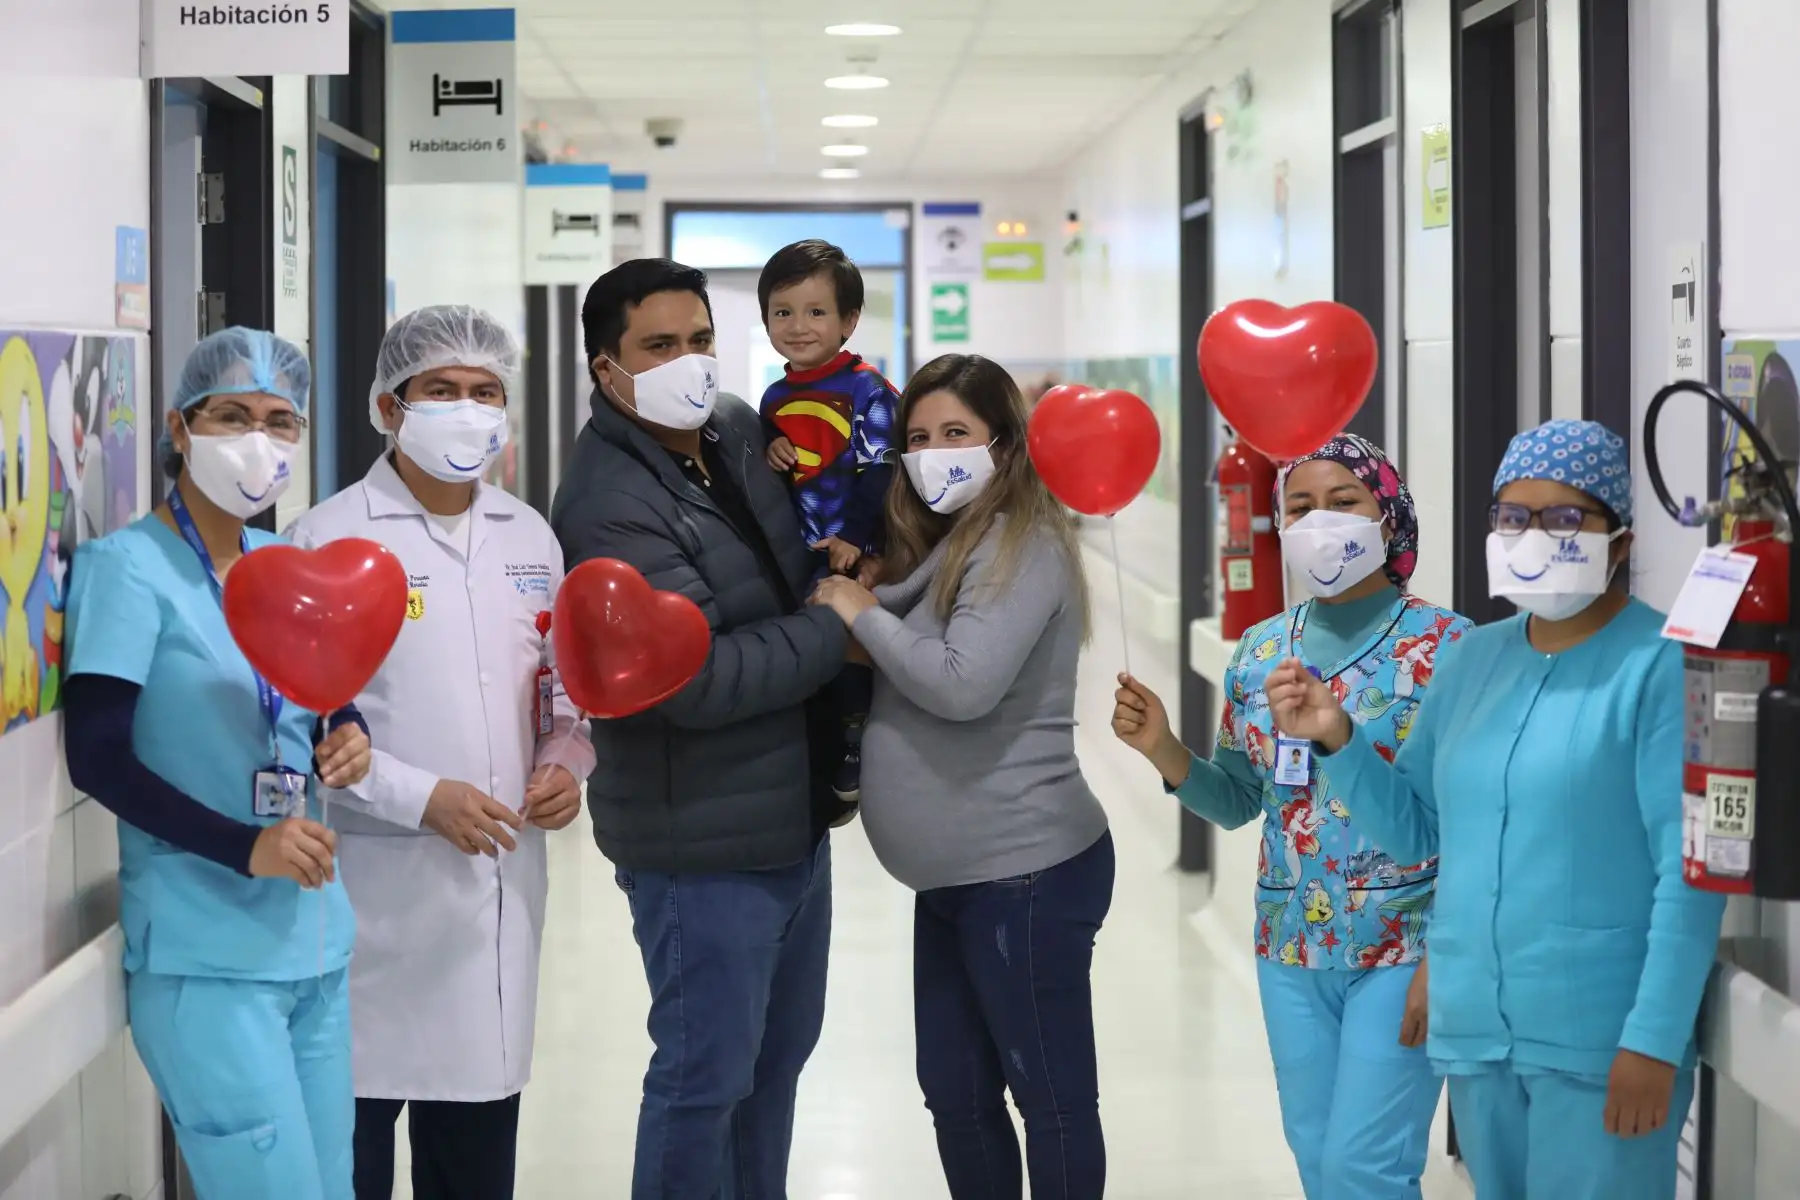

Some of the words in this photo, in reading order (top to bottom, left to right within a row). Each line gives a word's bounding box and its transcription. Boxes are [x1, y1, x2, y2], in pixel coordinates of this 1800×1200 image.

[180, 3, 308, 26] Habitación
[316, 3, 330, 23] 5
[409, 138, 492, 153] Habitación
[496, 138, 506, 151] 6
[946, 473, 973, 487] EsSalud
[1714, 795, 1747, 820] 165
[1714, 820, 1744, 833] INCOR
